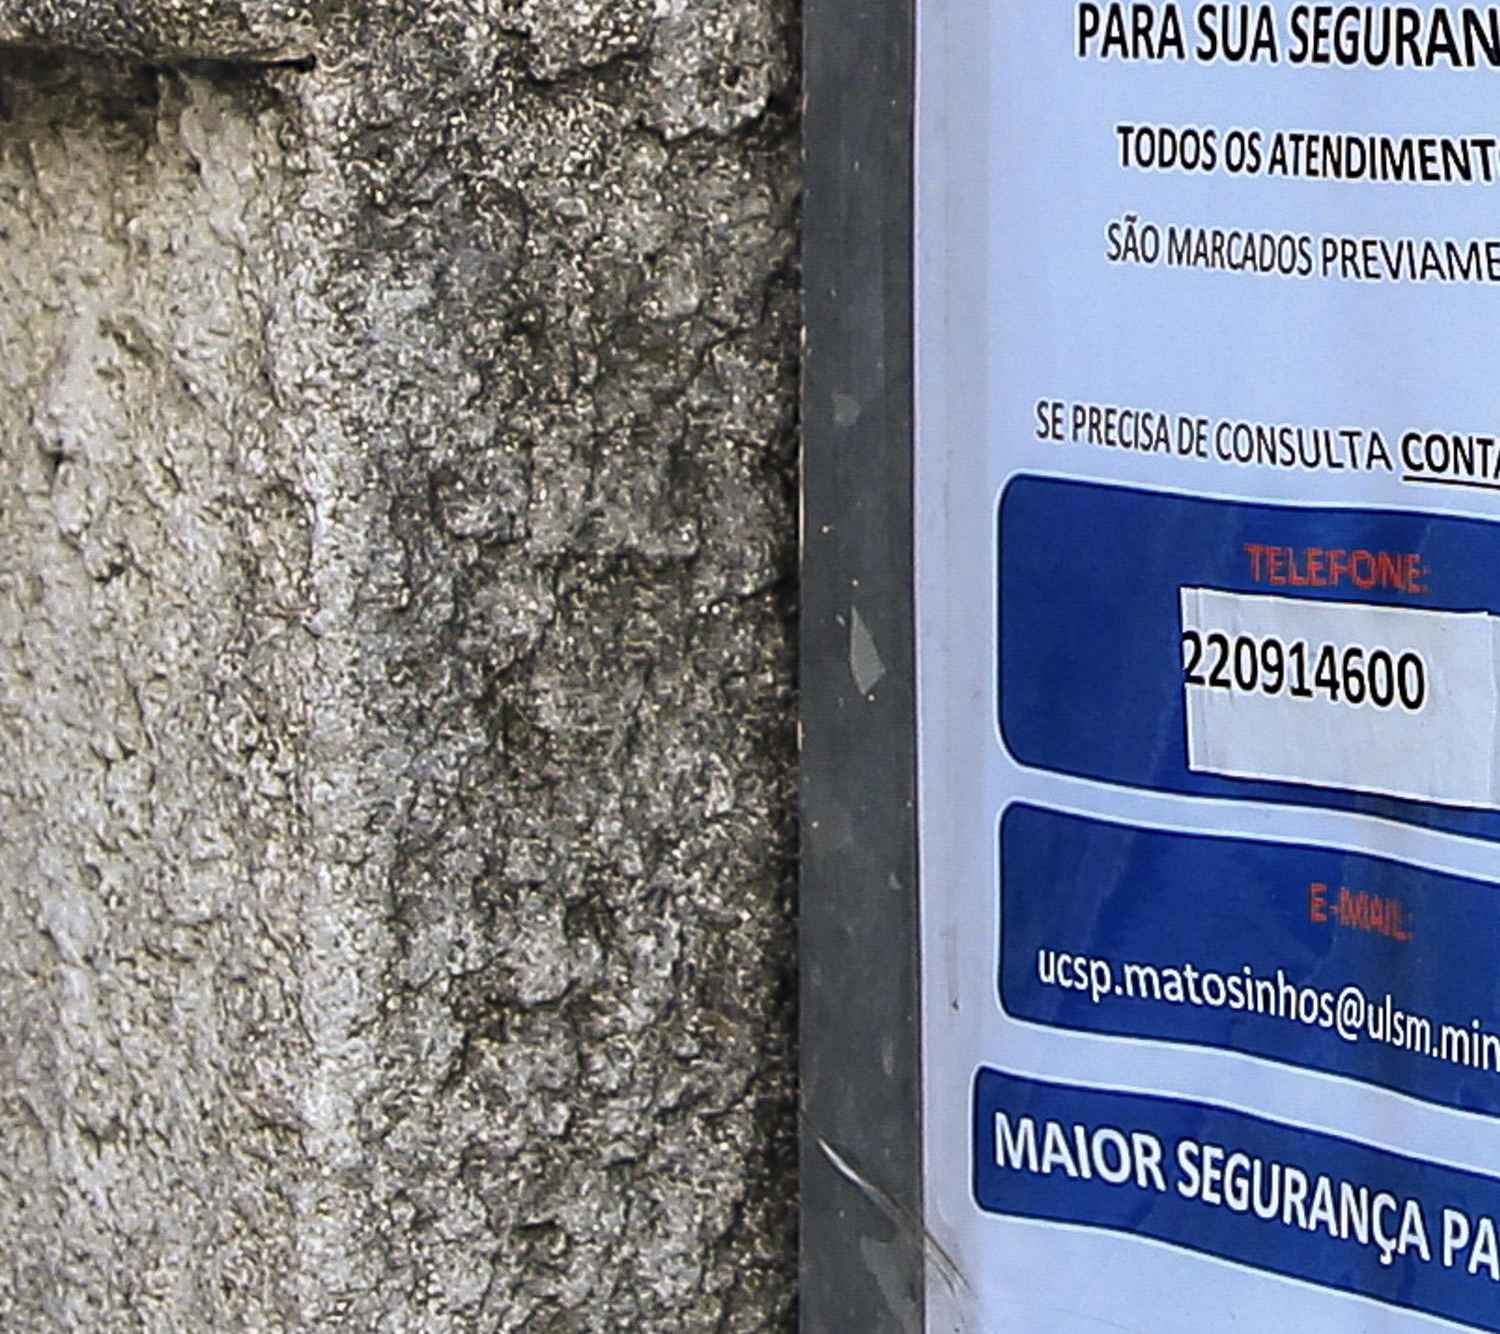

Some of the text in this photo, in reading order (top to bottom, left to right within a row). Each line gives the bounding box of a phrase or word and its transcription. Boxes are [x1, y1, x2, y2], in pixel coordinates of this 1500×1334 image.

[1078, 3, 1184, 60] PARA
[1197, 4, 1278, 63] SUA
[1117, 125, 1217, 171] TODOS
[1225, 131, 1262, 174] OS
[1106, 215, 1159, 263] SÃO
[1167, 226, 1312, 275] MARCADOS
[1036, 401, 1065, 440] SE
[1073, 405, 1171, 455] PRECISA
[1178, 417, 1208, 458] DE
[1216, 423, 1393, 471] CONSULTA
[1244, 543, 1432, 594] TELEFONE:
[1182, 630, 1426, 711] 220914600
[1310, 884, 1413, 941] E-MAIL:
[994, 1112, 1167, 1193] MAIOR
[1177, 1139, 1431, 1265] SEGURANÇA
